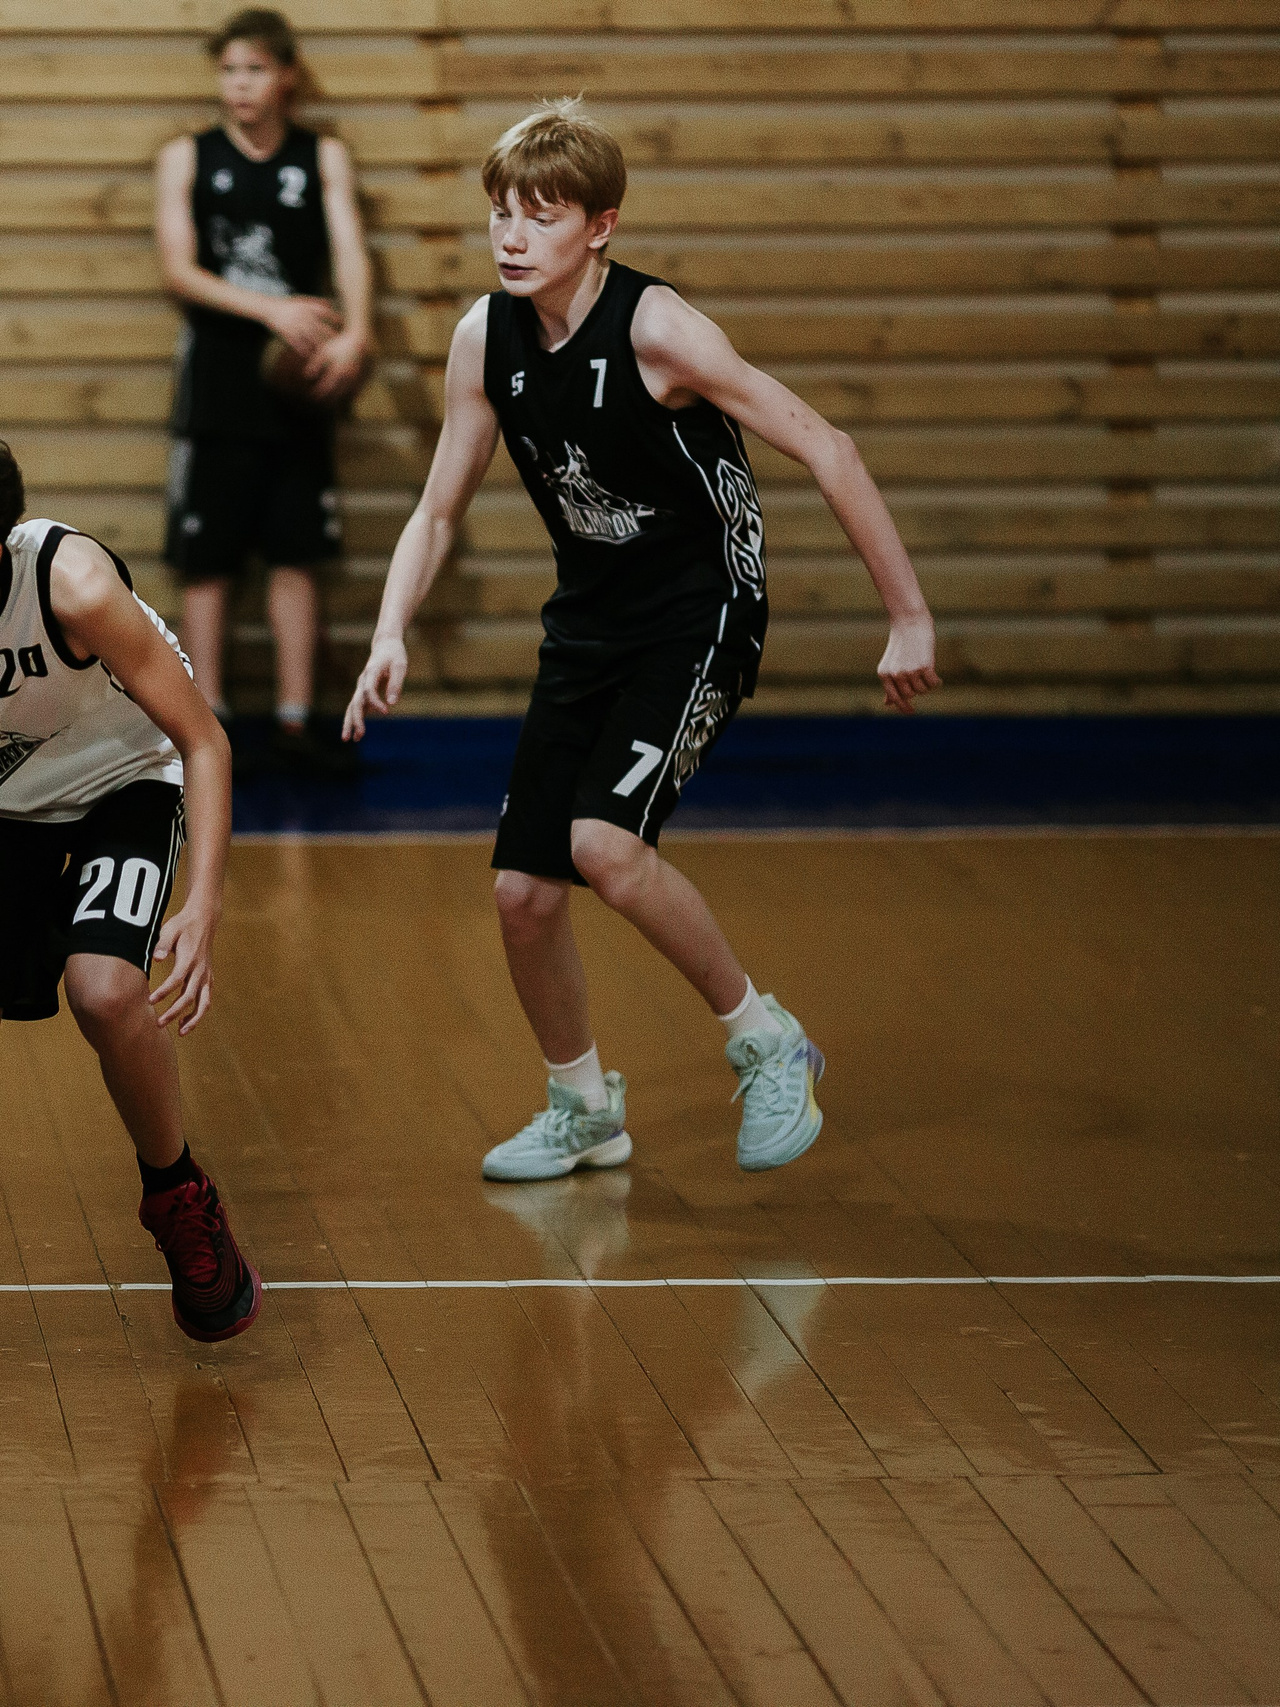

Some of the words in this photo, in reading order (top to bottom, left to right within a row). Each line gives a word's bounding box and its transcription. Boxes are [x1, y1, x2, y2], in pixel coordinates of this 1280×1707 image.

[277, 165, 308, 207] 2
[590, 359, 607, 407] 7
[613, 740, 663, 797] 7
[72, 856, 160, 927] 20
